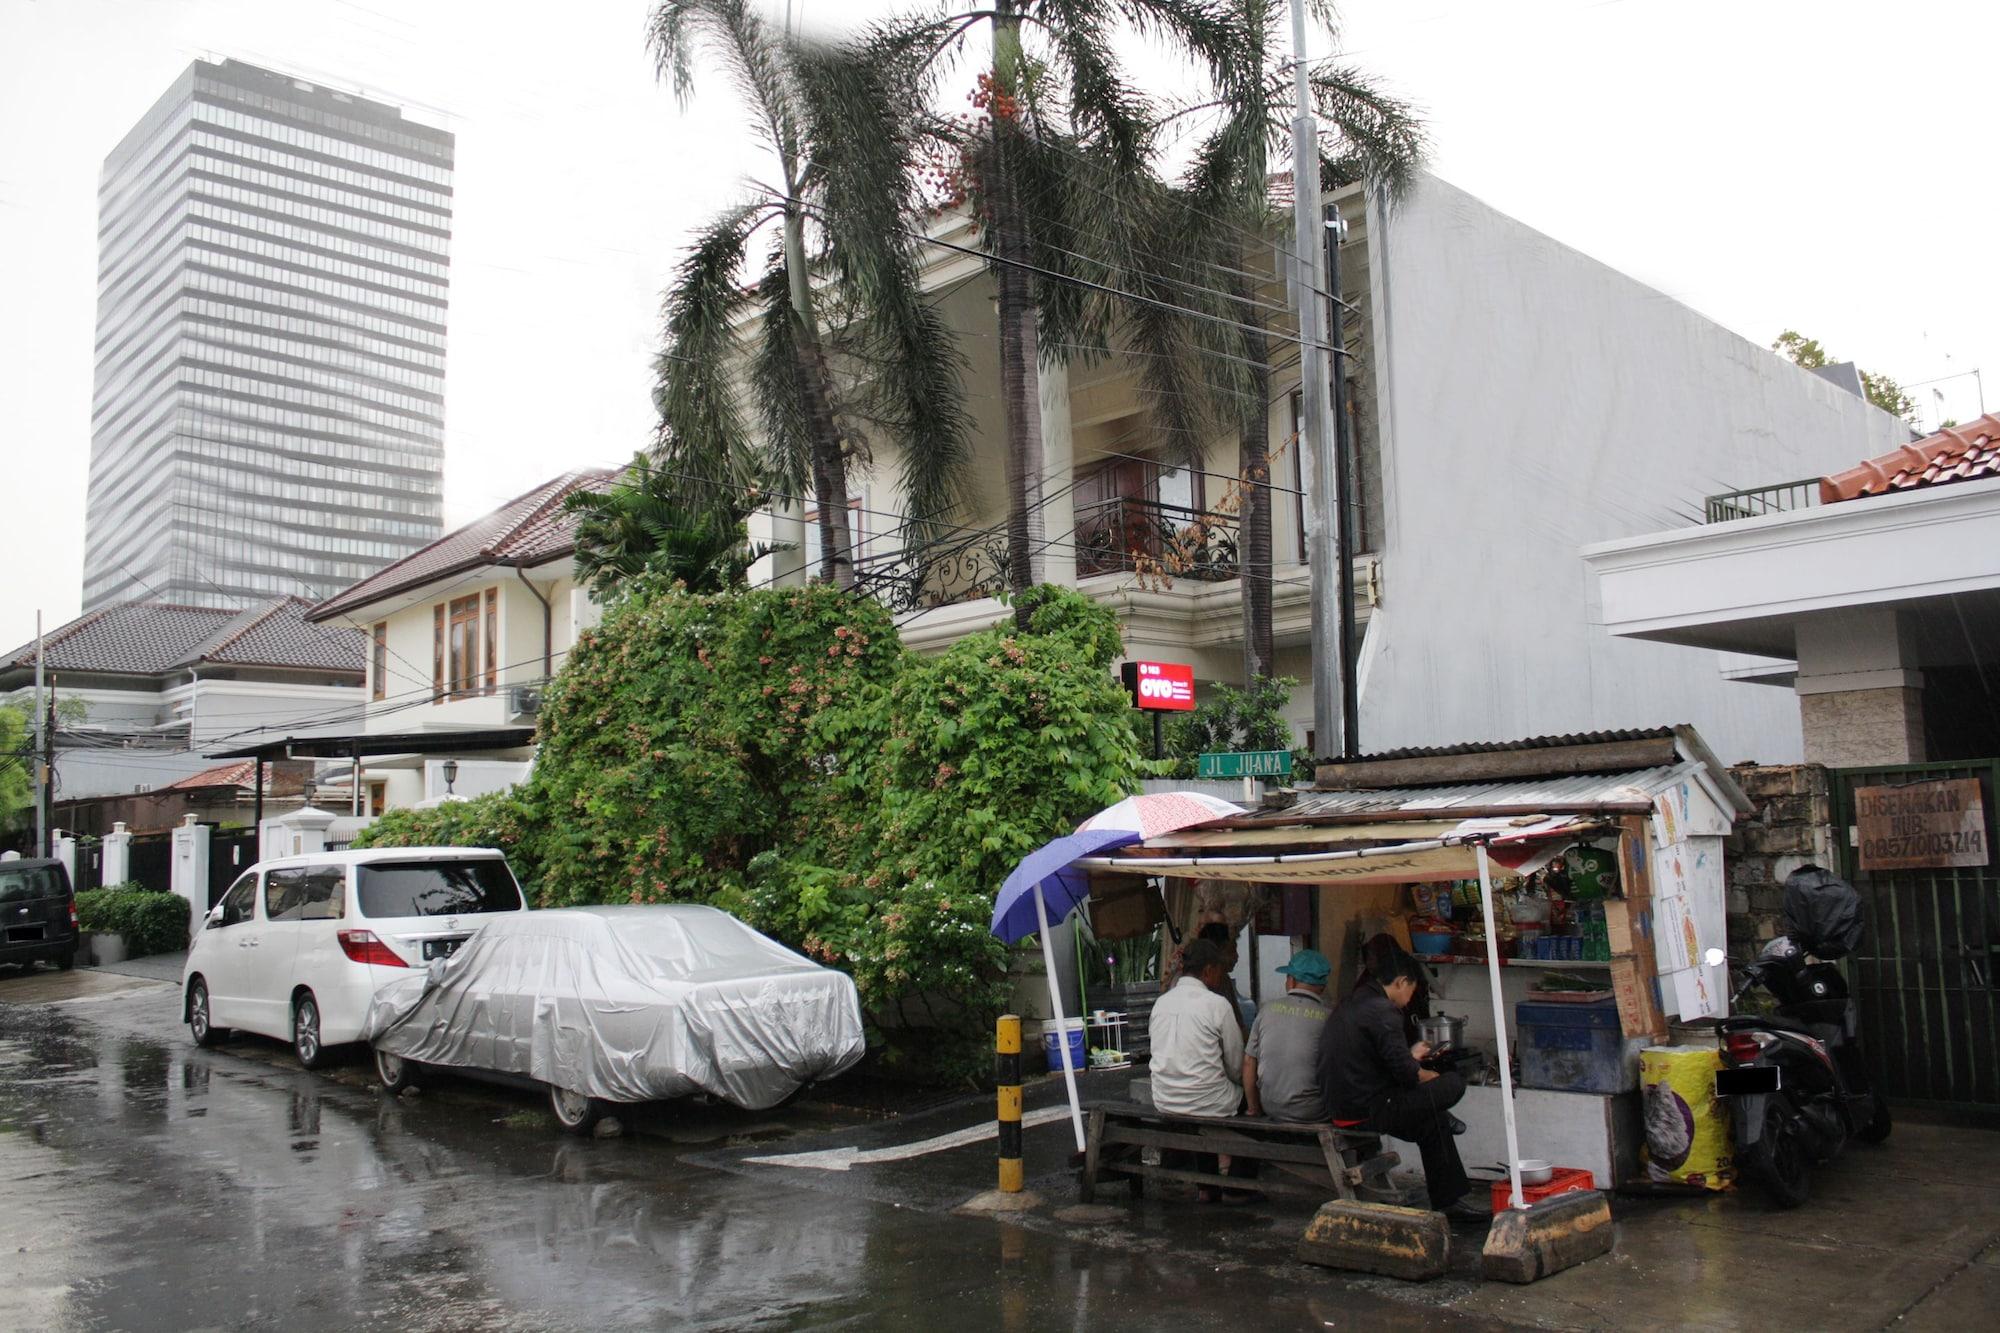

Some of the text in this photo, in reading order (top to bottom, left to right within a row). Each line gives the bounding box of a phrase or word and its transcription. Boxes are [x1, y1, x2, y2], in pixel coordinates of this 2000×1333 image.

[1140, 678, 1173, 698] OYO
[1206, 754, 1282, 775] JL JUANA
